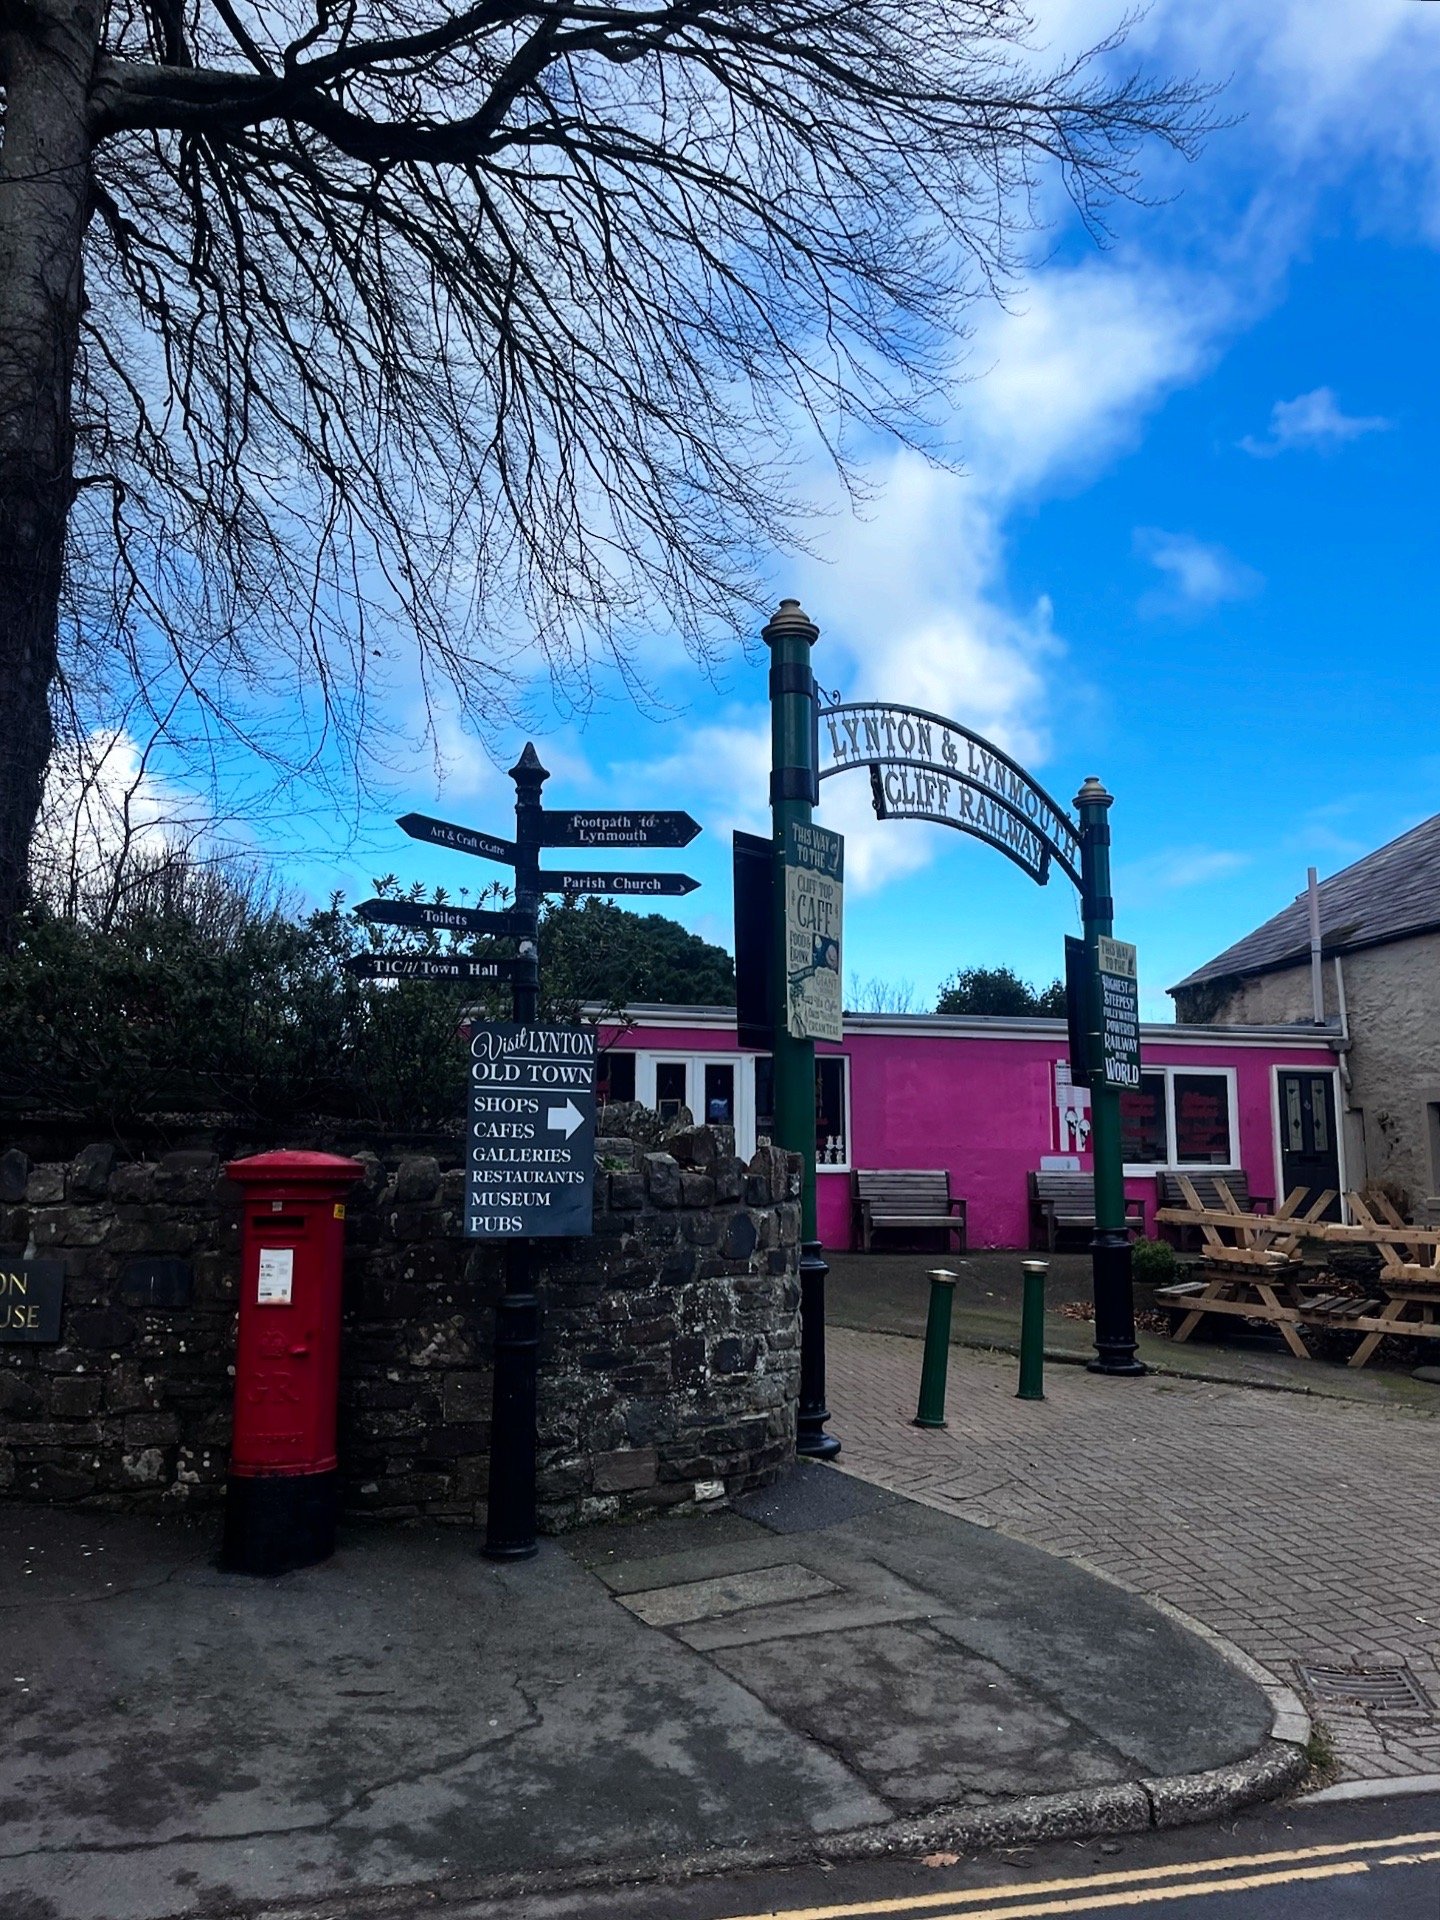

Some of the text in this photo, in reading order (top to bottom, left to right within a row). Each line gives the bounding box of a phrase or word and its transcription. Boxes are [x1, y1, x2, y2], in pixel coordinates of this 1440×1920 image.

[827, 714, 1079, 866] LYNTON & LYNMOUTH
[572, 815, 654, 829] Footpath to
[884, 770, 1043, 866] CLIFF RAILWAY
[430, 826, 446, 837] Art
[447, 830, 455, 840] &
[456, 833, 478, 848] Craft
[579, 830, 647, 843] Lynmouth
[792, 823, 831, 852] THIS WAY
[797, 848, 826, 868] TO THE
[563, 877, 662, 890] Parish Church
[798, 874, 834, 898] CLIFF TOP
[423, 910, 468, 926] Toilets
[789, 947, 809, 964] DRINK
[1101, 939, 1129, 959] THIS WAY
[420, 962, 459, 975] Town
[469, 963, 498, 976] Hall
[1105, 957, 1126, 973] TO THE
[1102, 974, 1129, 994] HIGHEST
[1104, 992, 1135, 1011] STEEPEST
[1103, 1006, 1137, 1023] FULLY WATER
[808, 1019, 839, 1036] CREAM TEAS
[1106, 1019, 1136, 1037] POWERED
[471, 1027, 596, 1061] Visit LYNTON
[1104, 1032, 1138, 1053] RAILWAY
[472, 1063, 593, 1084] OLD TOWN
[1105, 1057, 1139, 1086] WORLD
[474, 1097, 539, 1114] SHOPS
[473, 1122, 535, 1139] CAFES
[473, 1147, 572, 1163] GALLERIES
[472, 1171, 585, 1184] RESTAURANTS
[471, 1192, 551, 1206] MUSEUM
[470, 1216, 523, 1233] PUBS
